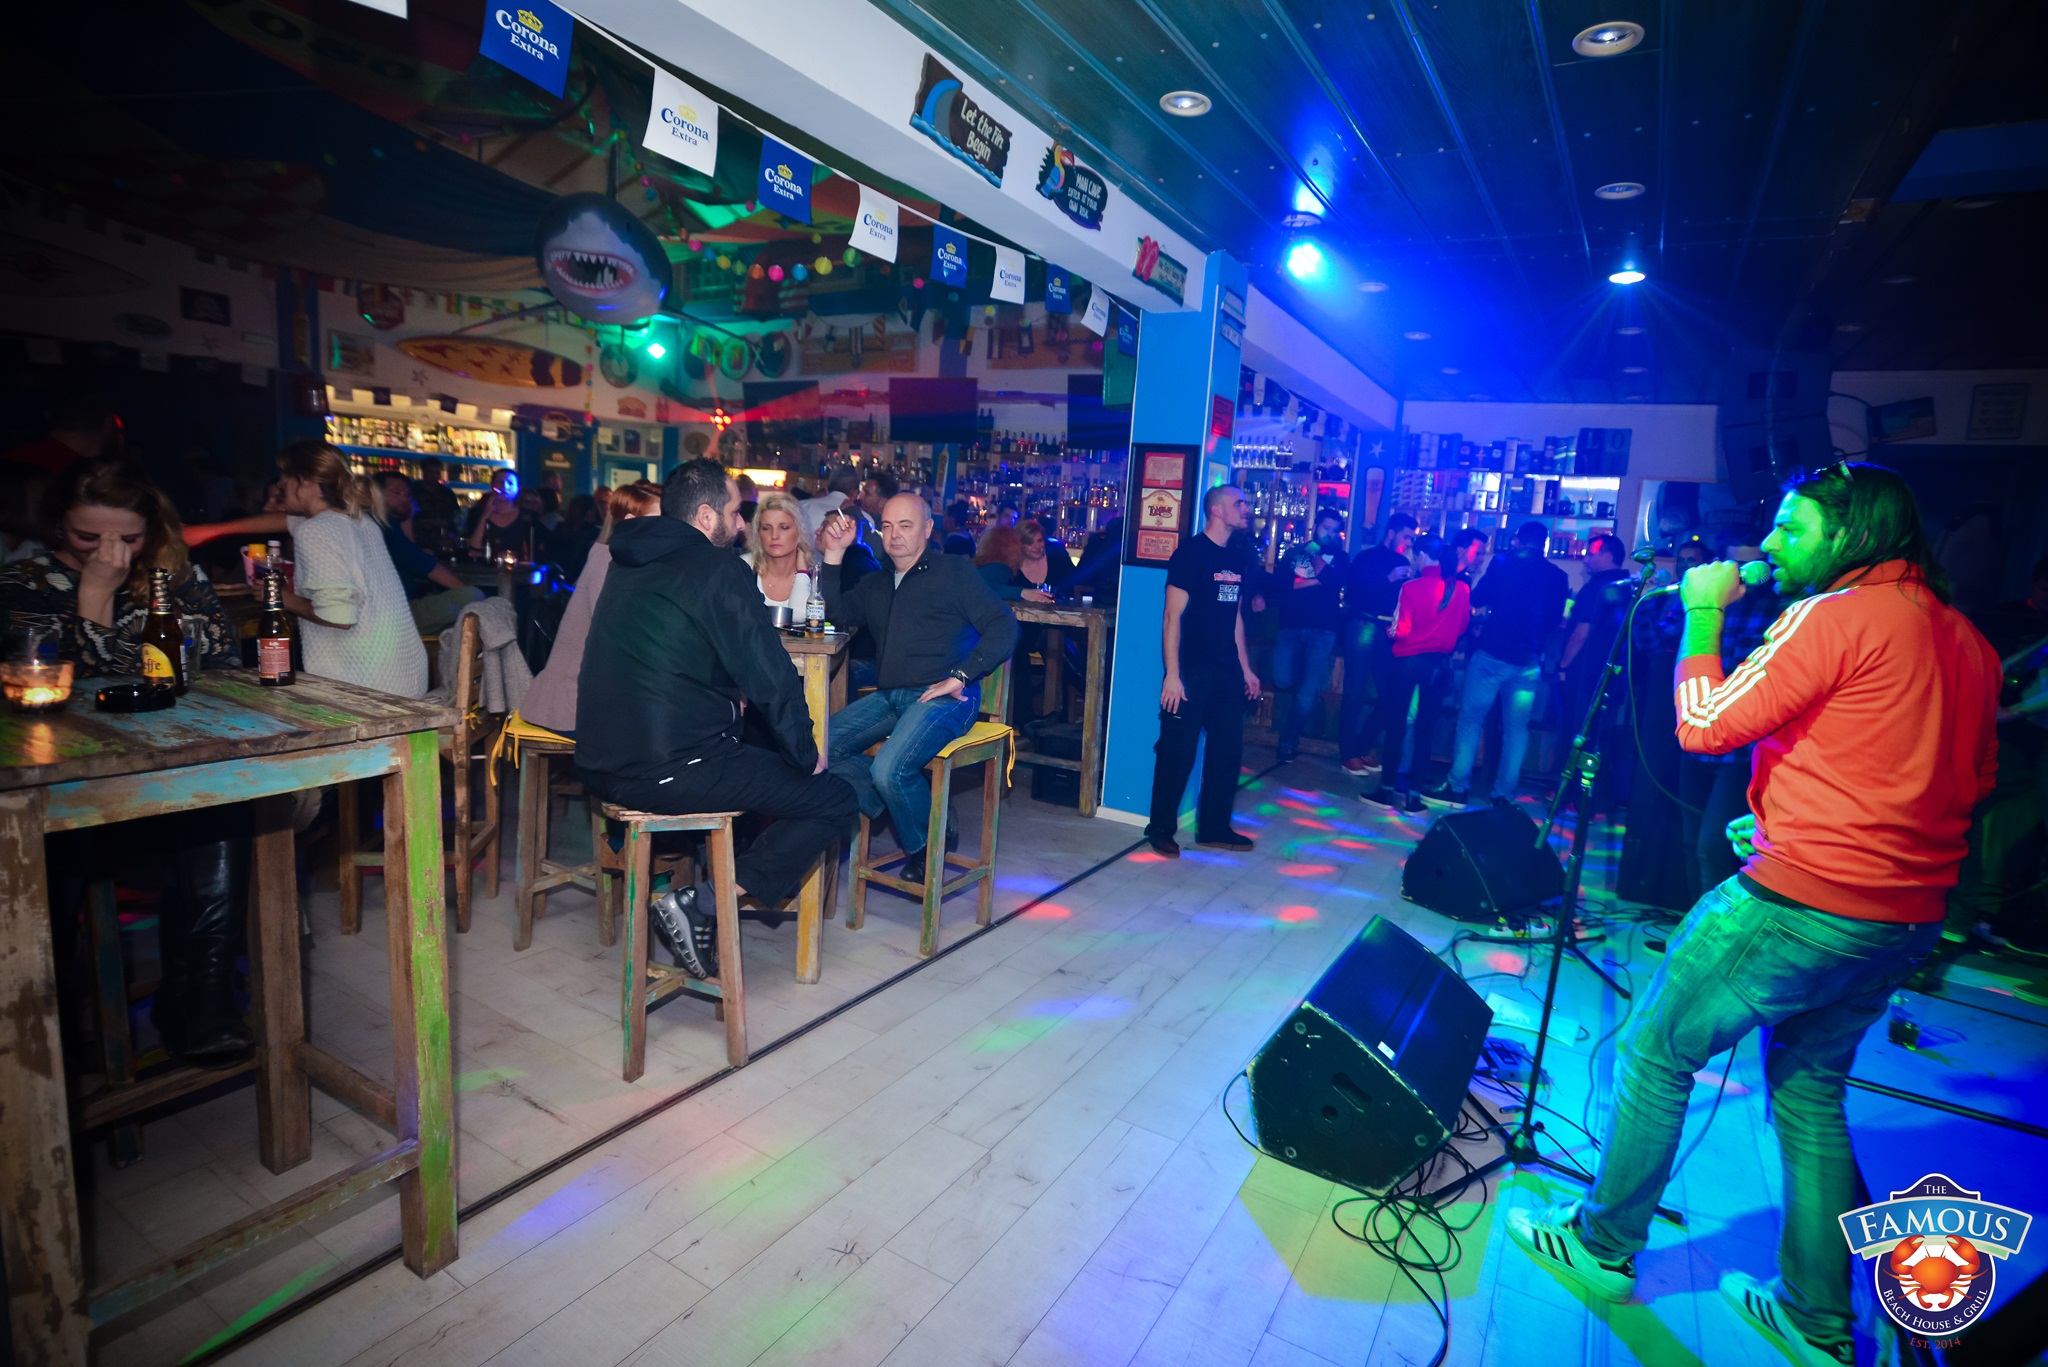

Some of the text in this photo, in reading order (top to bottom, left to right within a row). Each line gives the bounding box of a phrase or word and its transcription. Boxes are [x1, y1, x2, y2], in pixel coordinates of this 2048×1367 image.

[495, 9, 560, 60] Corona
[510, 32, 544, 61] Extra
[660, 107, 710, 143] Corona
[960, 98, 978, 127] Let
[977, 114, 992, 139] the
[671, 126, 698, 147] Extra
[966, 130, 992, 163] Begin
[764, 167, 804, 197] Corona
[773, 183, 795, 201] Extra
[1075, 173, 1089, 193] MAN
[863, 213, 894, 236] Corona
[869, 227, 886, 241] Extra
[937, 247, 964, 266] Corona
[942, 259, 957, 271] Extra
[999, 269, 1022, 283] Corona
[1003, 279, 1017, 288] Extra
[1048, 282, 1067, 295] Corona
[143, 658, 161, 673] effe
